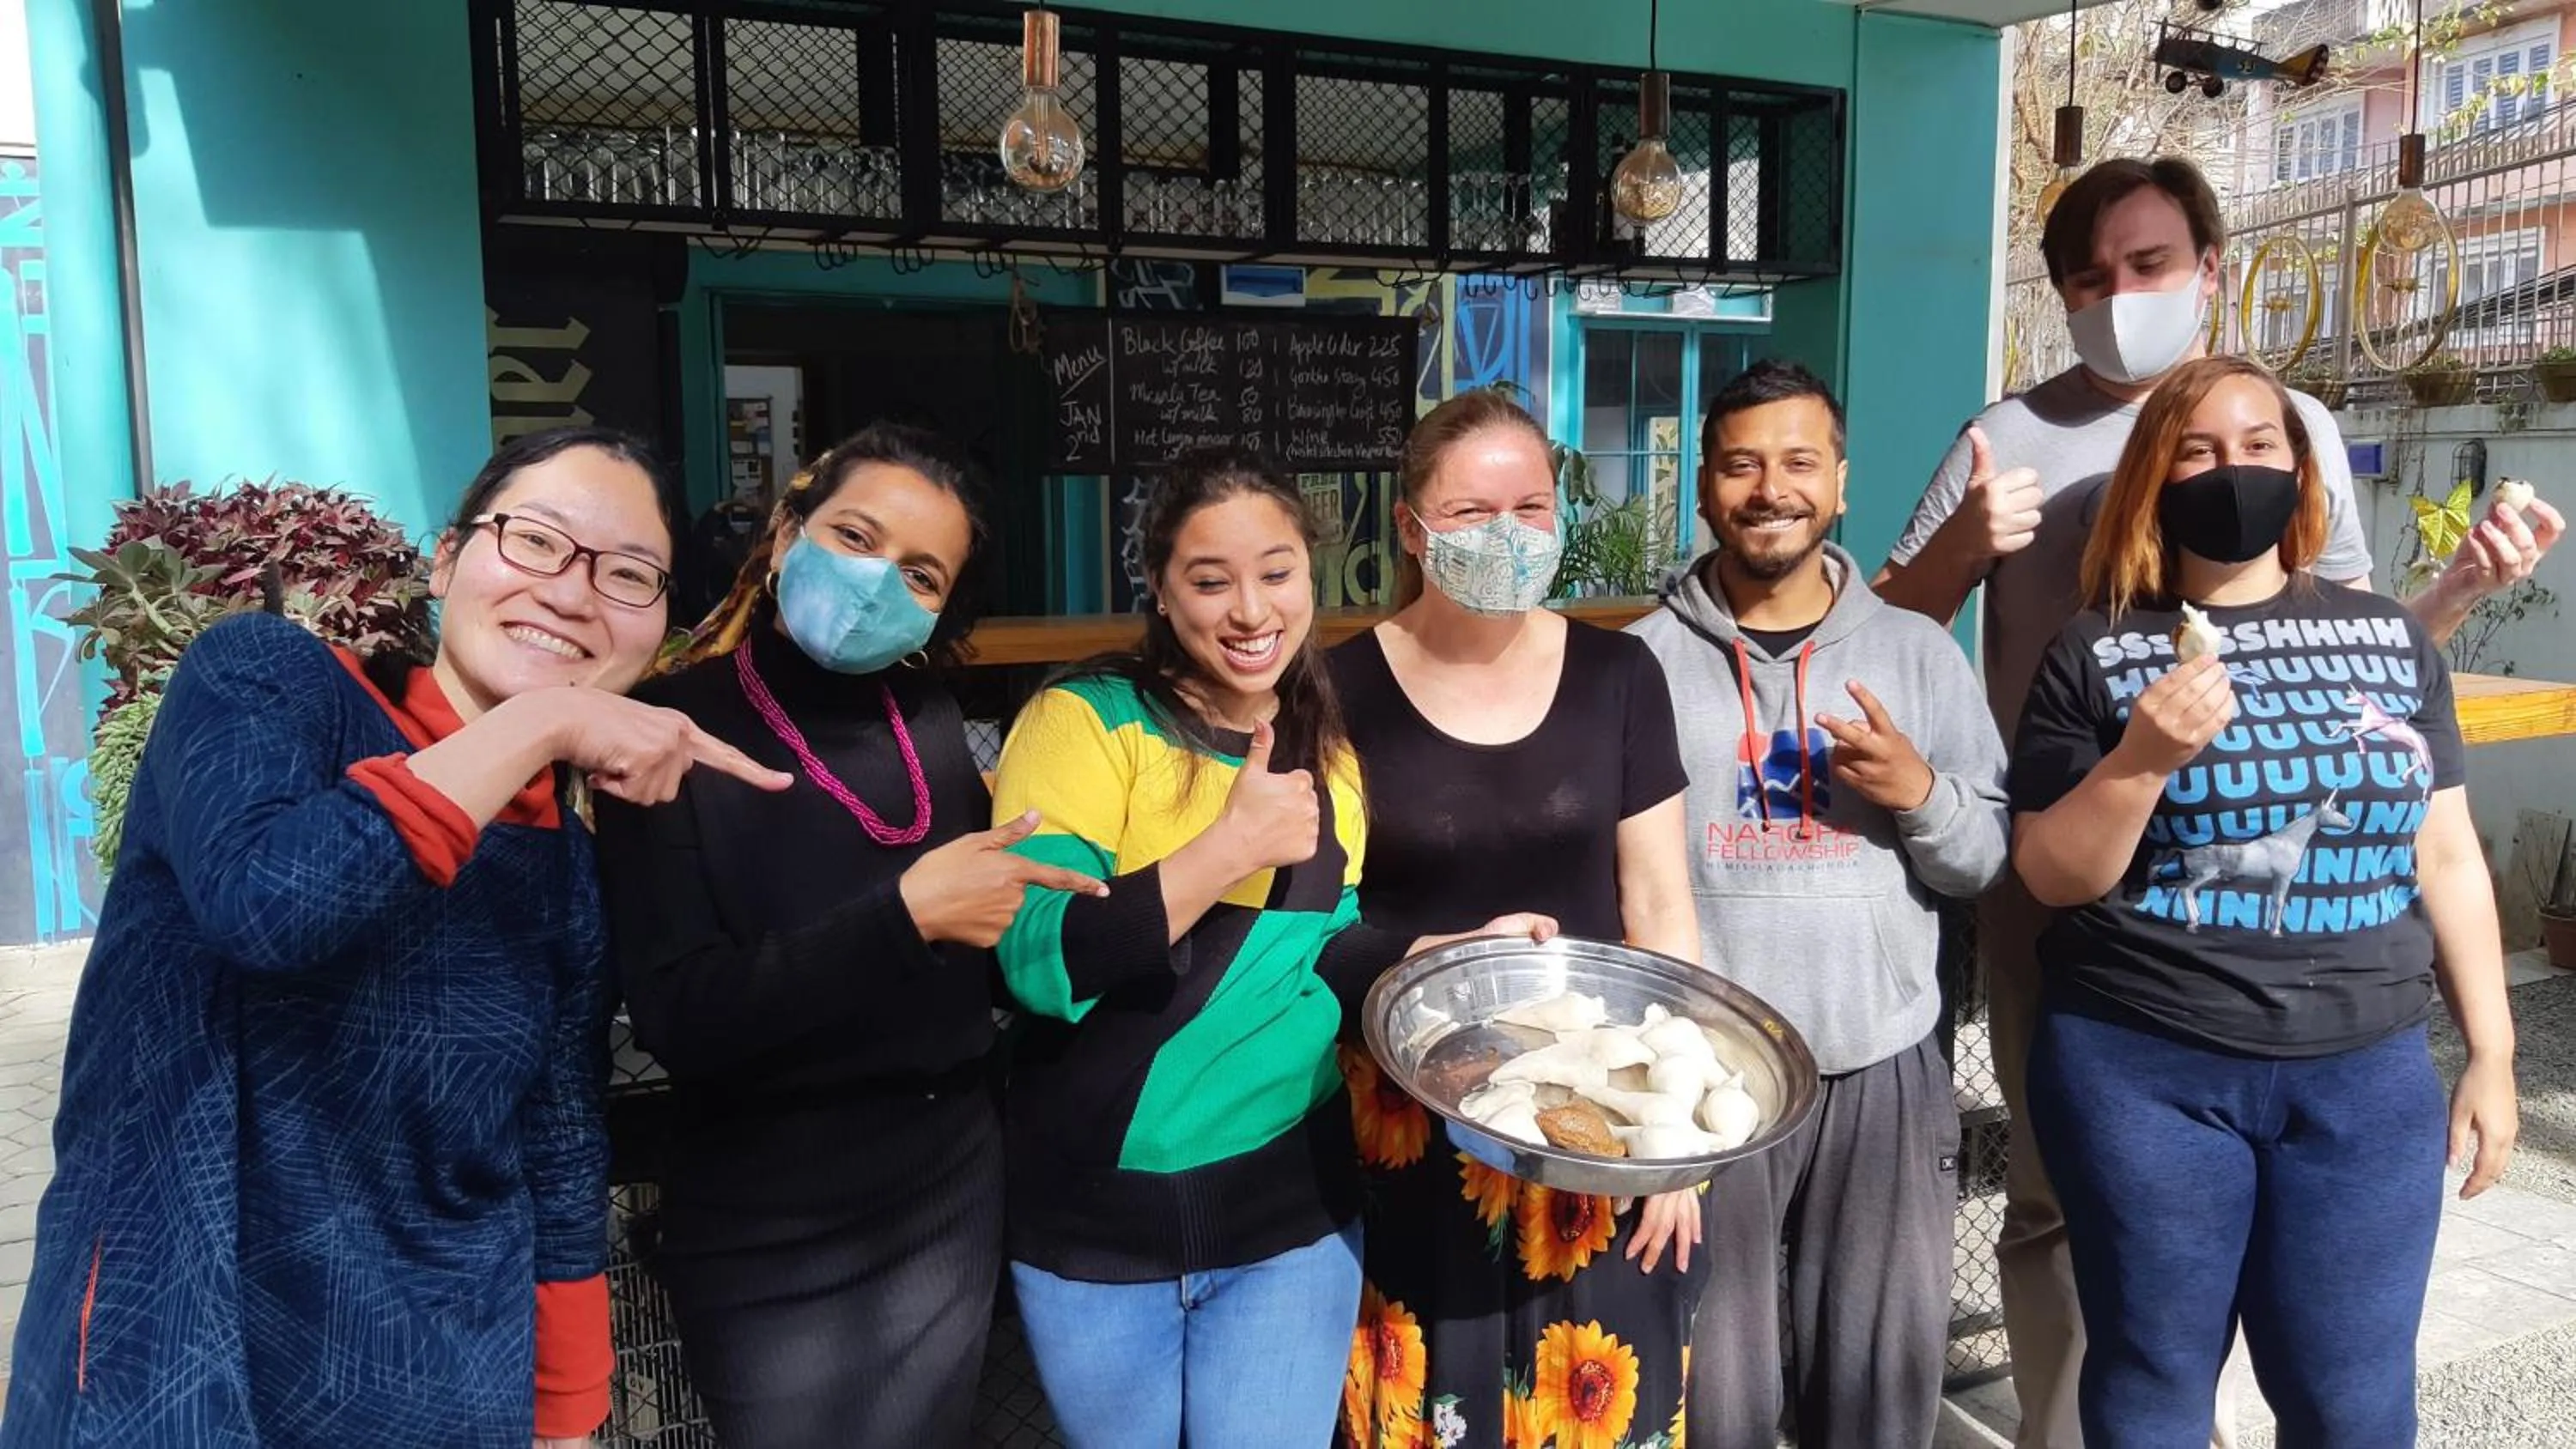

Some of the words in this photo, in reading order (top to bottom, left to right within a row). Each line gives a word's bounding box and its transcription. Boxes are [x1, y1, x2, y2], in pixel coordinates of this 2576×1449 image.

[1121, 326, 1176, 355] Black
[1180, 327, 1225, 359] Coffee
[1290, 332, 1323, 365] Apple
[1369, 334, 1402, 358] 225
[1054, 344, 1103, 385] Menu
[1239, 357, 1263, 379] 120
[1371, 366, 1400, 388] 450
[1188, 383, 1222, 403] Tea
[1237, 386, 1260, 407] 50
[1060, 401, 1102, 428] JAN
[1182, 403, 1218, 422] milk
[1242, 408, 1262, 422] 80
[1066, 426, 1101, 462] 2nd
[1291, 427, 1327, 445] Wine
[1706, 842, 1862, 862] FELLOWSHIP
